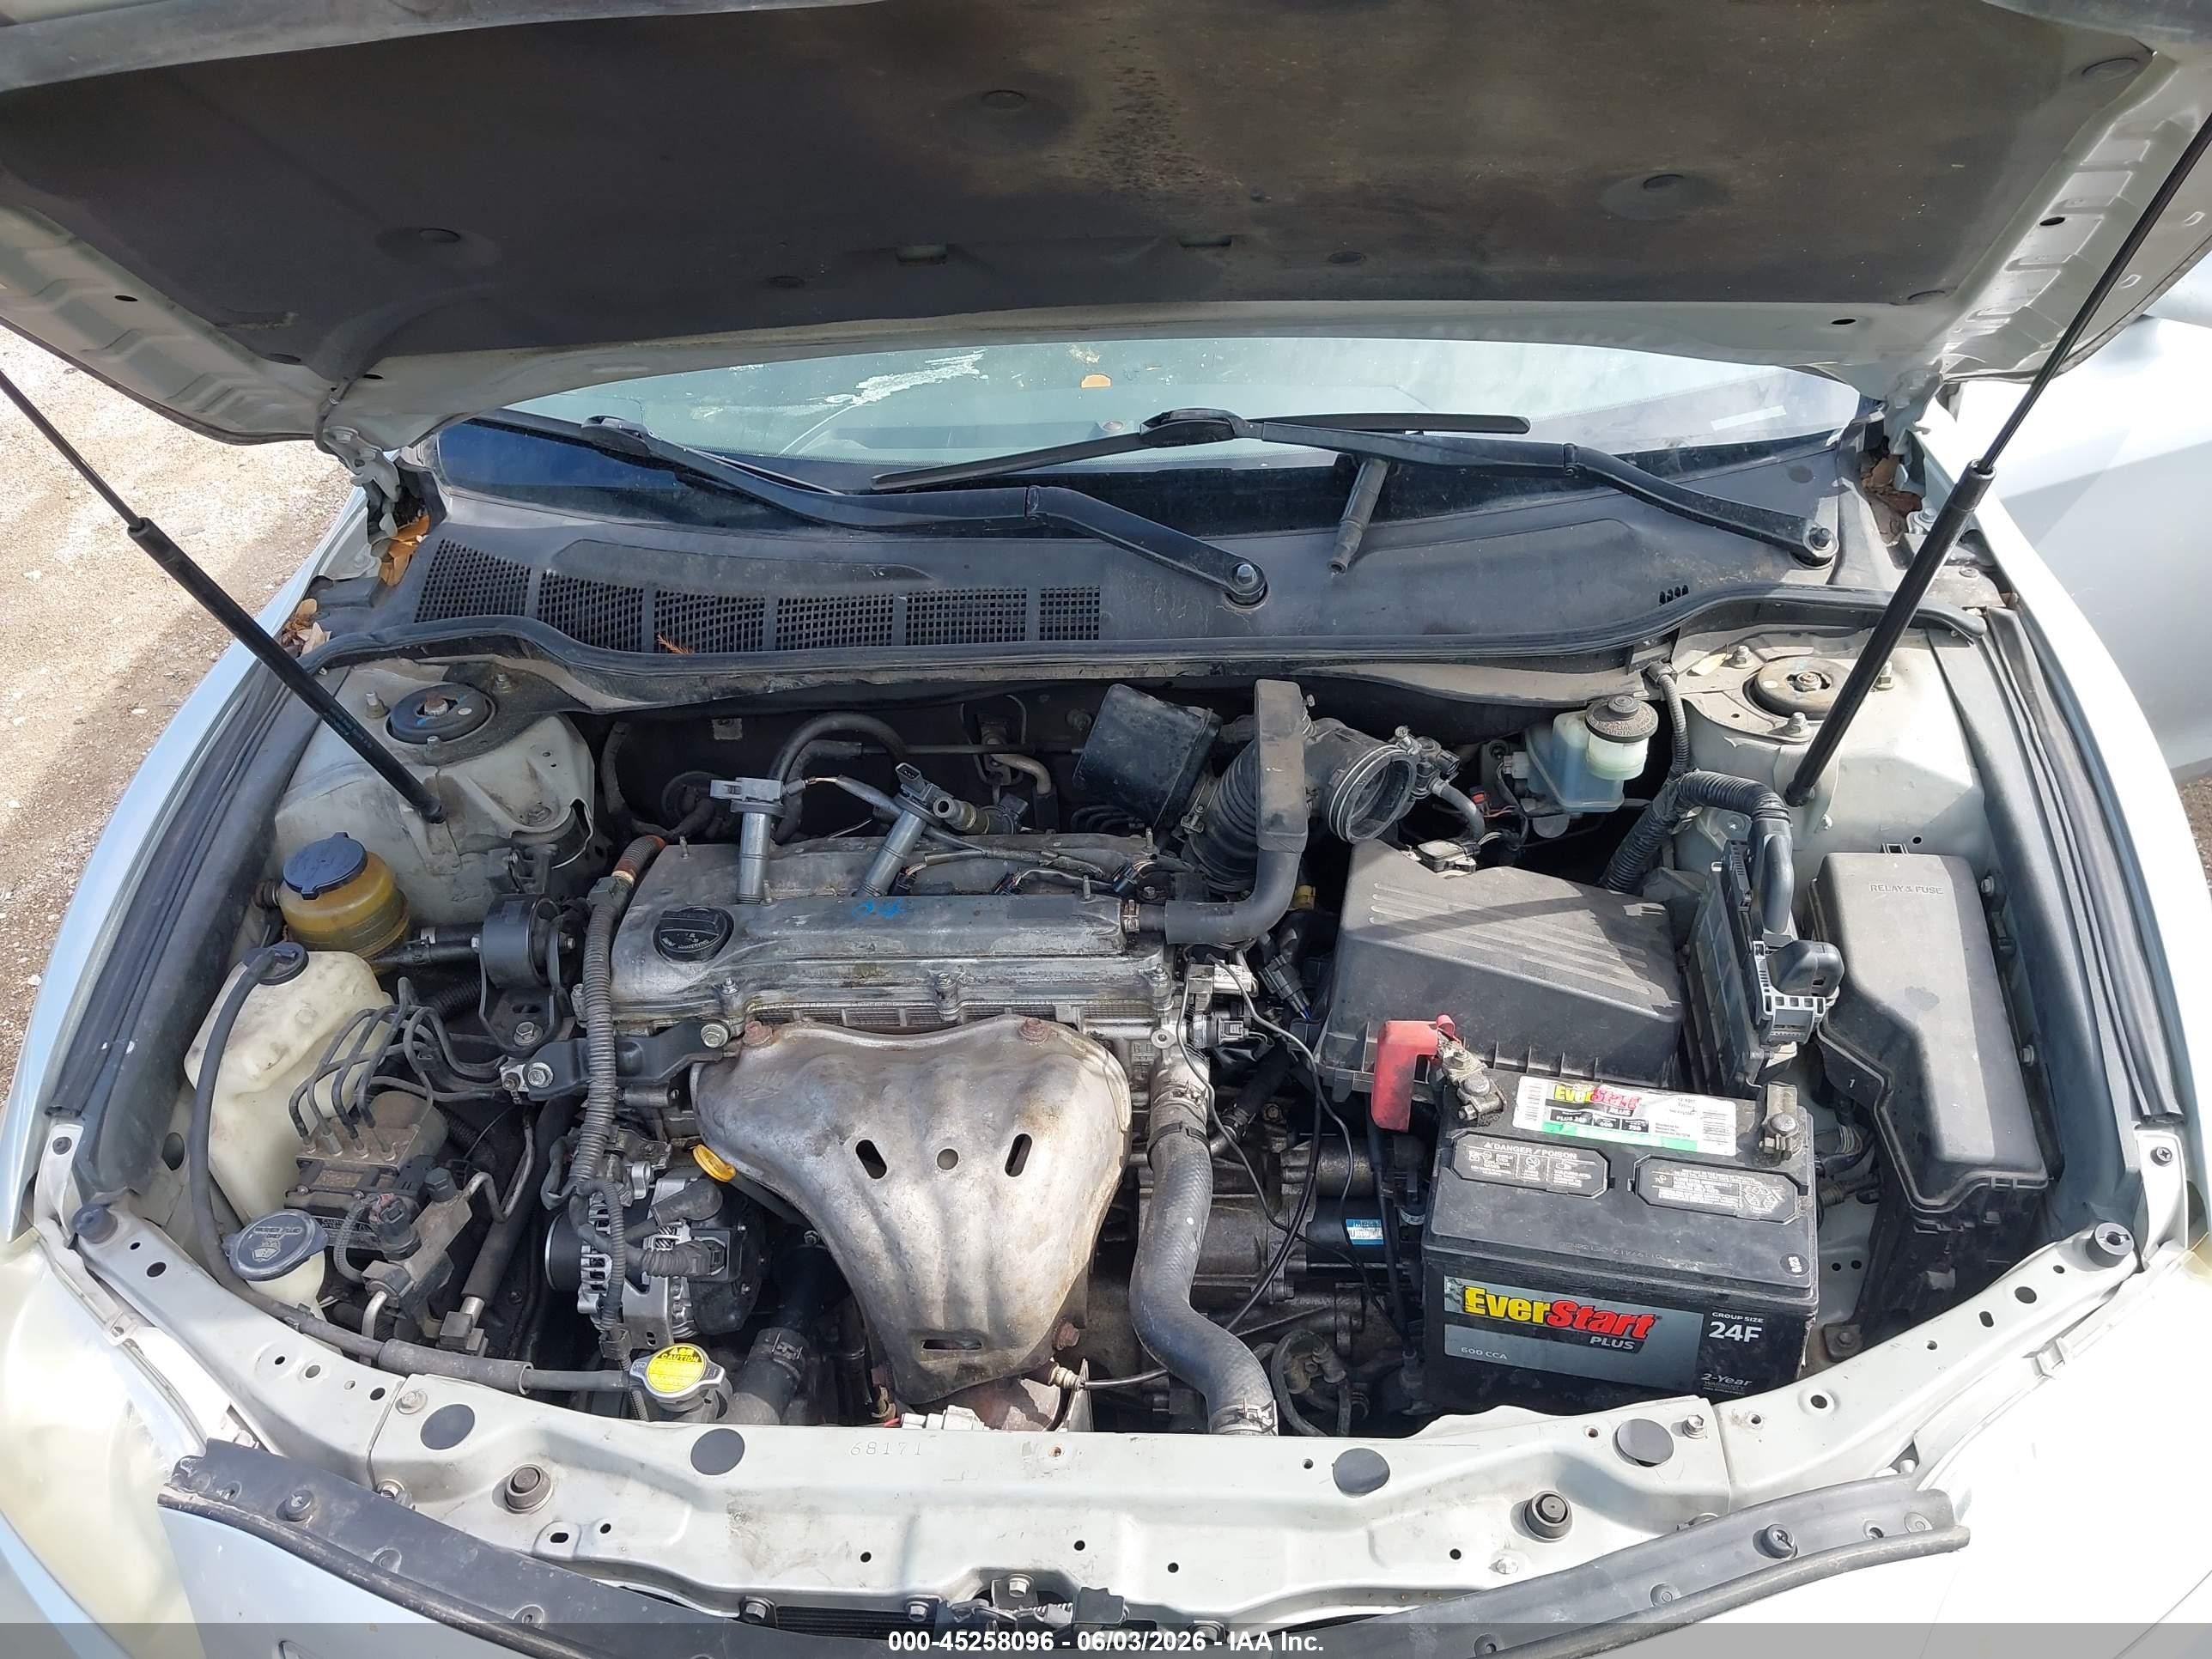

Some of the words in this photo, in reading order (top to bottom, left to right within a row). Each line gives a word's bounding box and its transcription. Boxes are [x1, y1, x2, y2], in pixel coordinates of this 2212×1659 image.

[1905, 885, 1912, 894] &
[1915, 885, 1944, 895] FUSE
[1554, 1084, 1641, 1109] EverStart
[1494, 1143, 1533, 1155] DANGER
[1541, 1149, 1578, 1160] POISON
[1463, 1285, 1656, 1340] EverStart
[1711, 1311, 1743, 1321] GROUP
[1708, 1321, 1763, 1342] 24F
[1589, 1335, 1635, 1350] PLUS
[660, 1353, 700, 1363] CAUTION
[1461, 1346, 1483, 1357] 600
[1485, 1350, 1508, 1360] CCA
[1700, 1373, 1753, 1387] 2-Year
[850, 1442, 922, 1455] 68171
